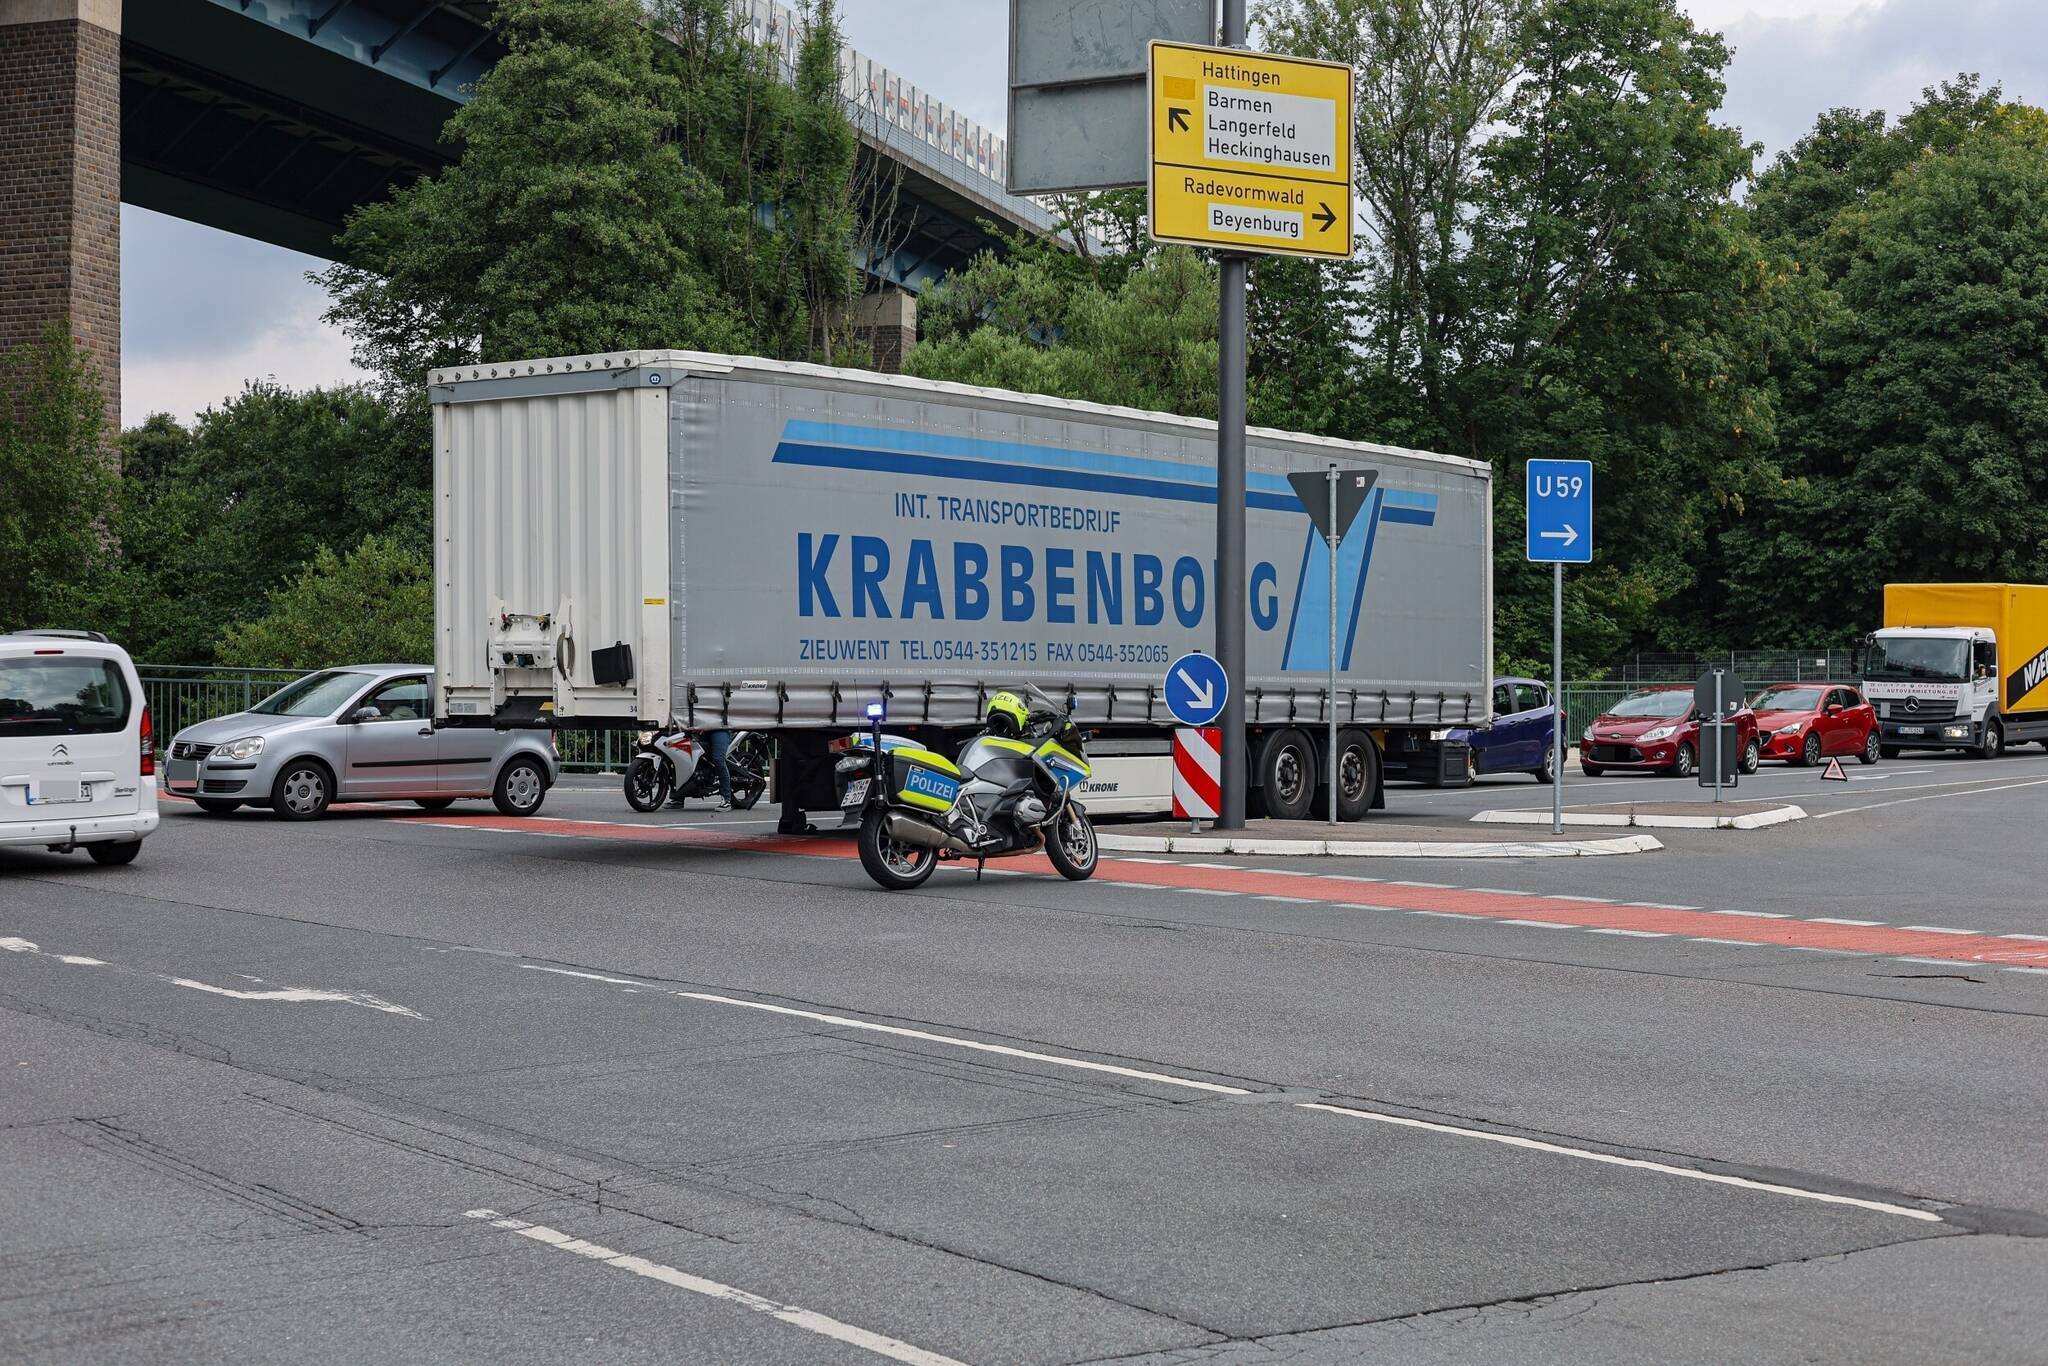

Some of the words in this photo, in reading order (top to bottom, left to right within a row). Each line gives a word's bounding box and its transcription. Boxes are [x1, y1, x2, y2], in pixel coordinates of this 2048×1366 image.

[1203, 61, 1280, 87] Hattingen
[1208, 91, 1272, 113] Barmen
[1208, 115, 1296, 139] Langerfeld
[1208, 138, 1331, 166] Heckinghausen
[1184, 177, 1304, 205] Radevormwald
[1213, 209, 1299, 237] Beyenburg
[1536, 475, 1552, 497] U
[1556, 476, 1583, 498] 59
[895, 493, 930, 519] INT.
[937, 496, 1120, 532] TRANSPORTBEDRIJF
[798, 532, 1279, 631] KRABBENBOG
[800, 639, 890, 660] ZIEUWENT
[1047, 643, 1073, 662] FAX
[1078, 643, 1169, 662] 0544-352065
[910, 774, 954, 799] POLIZEI
[1089, 783, 1119, 792] KRONE
